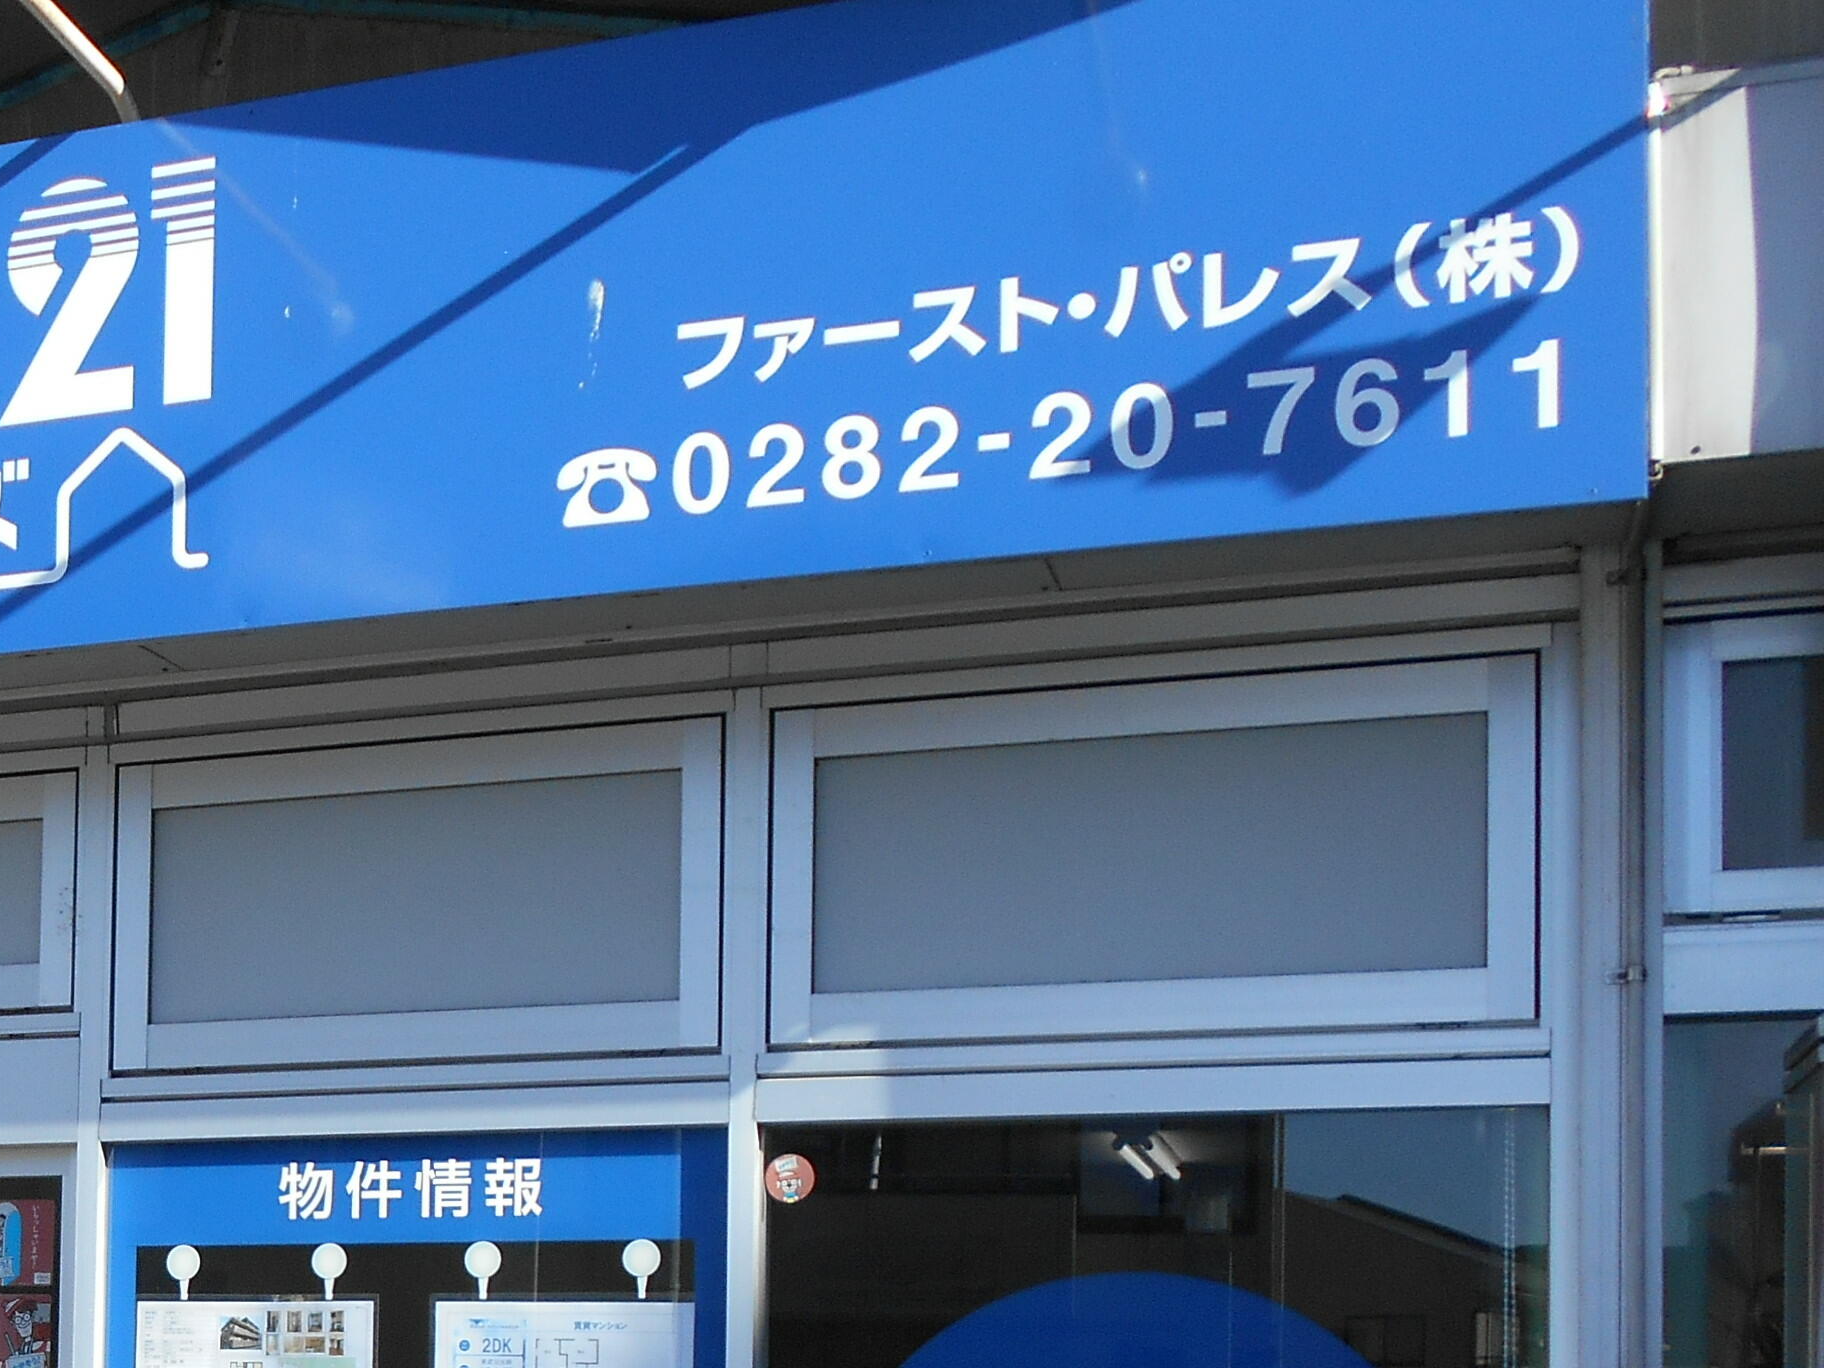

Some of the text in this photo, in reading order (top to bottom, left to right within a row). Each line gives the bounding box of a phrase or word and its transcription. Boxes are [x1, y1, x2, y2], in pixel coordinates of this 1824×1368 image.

[670, 337, 1563, 515] 0282-20-7611
[278, 1158, 543, 1220] 物件情報
[482, 1338, 512, 1354] 2DK
